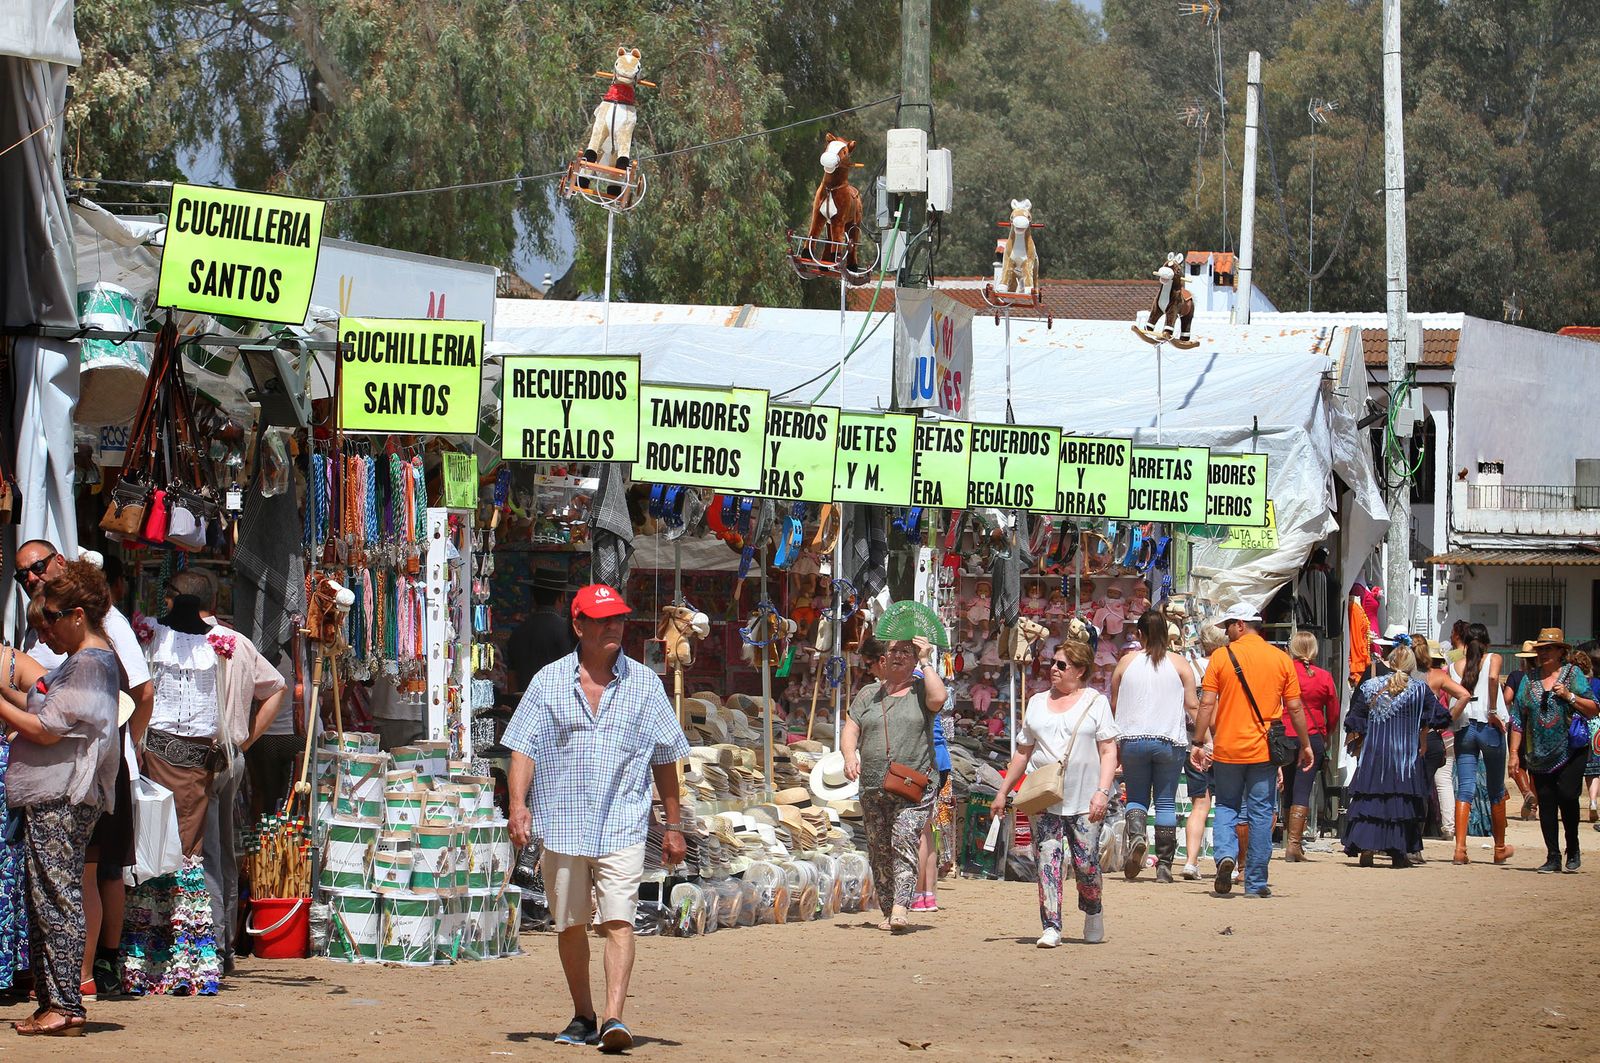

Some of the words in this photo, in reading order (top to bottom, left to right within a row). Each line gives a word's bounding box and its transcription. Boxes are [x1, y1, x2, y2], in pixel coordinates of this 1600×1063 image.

[176, 198, 311, 248] CUCHILLERIA
[188, 259, 282, 303] SANTOS
[343, 331, 476, 367] CUCHILLERIA
[513, 368, 627, 400] RECUERDOS
[364, 382, 450, 416] SANTOS
[561, 400, 573, 428] Y
[650, 398, 750, 433] TAMBORES
[522, 429, 614, 459] REGALOS
[916, 426, 964, 453] RETAS
[972, 428, 1051, 456] ECUERDOS
[646, 442, 741, 477] ROCIEROS
[771, 441, 781, 467] Y
[914, 452, 922, 477] E
[999, 456, 1008, 480] Y
[1077, 468, 1085, 489] Y
[1131, 457, 1193, 481] ARRETAS
[750, 469, 804, 498] RRAS
[914, 479, 943, 505] ERA
[968, 481, 1034, 507] REGALOS
[1057, 491, 1107, 515] ORRAS
[1130, 489, 1189, 512] OCIERAS
[1207, 495, 1253, 517] CIEROS
[1241, 540, 1274, 549] REGALO
[1261, 529, 1273, 540] DE
